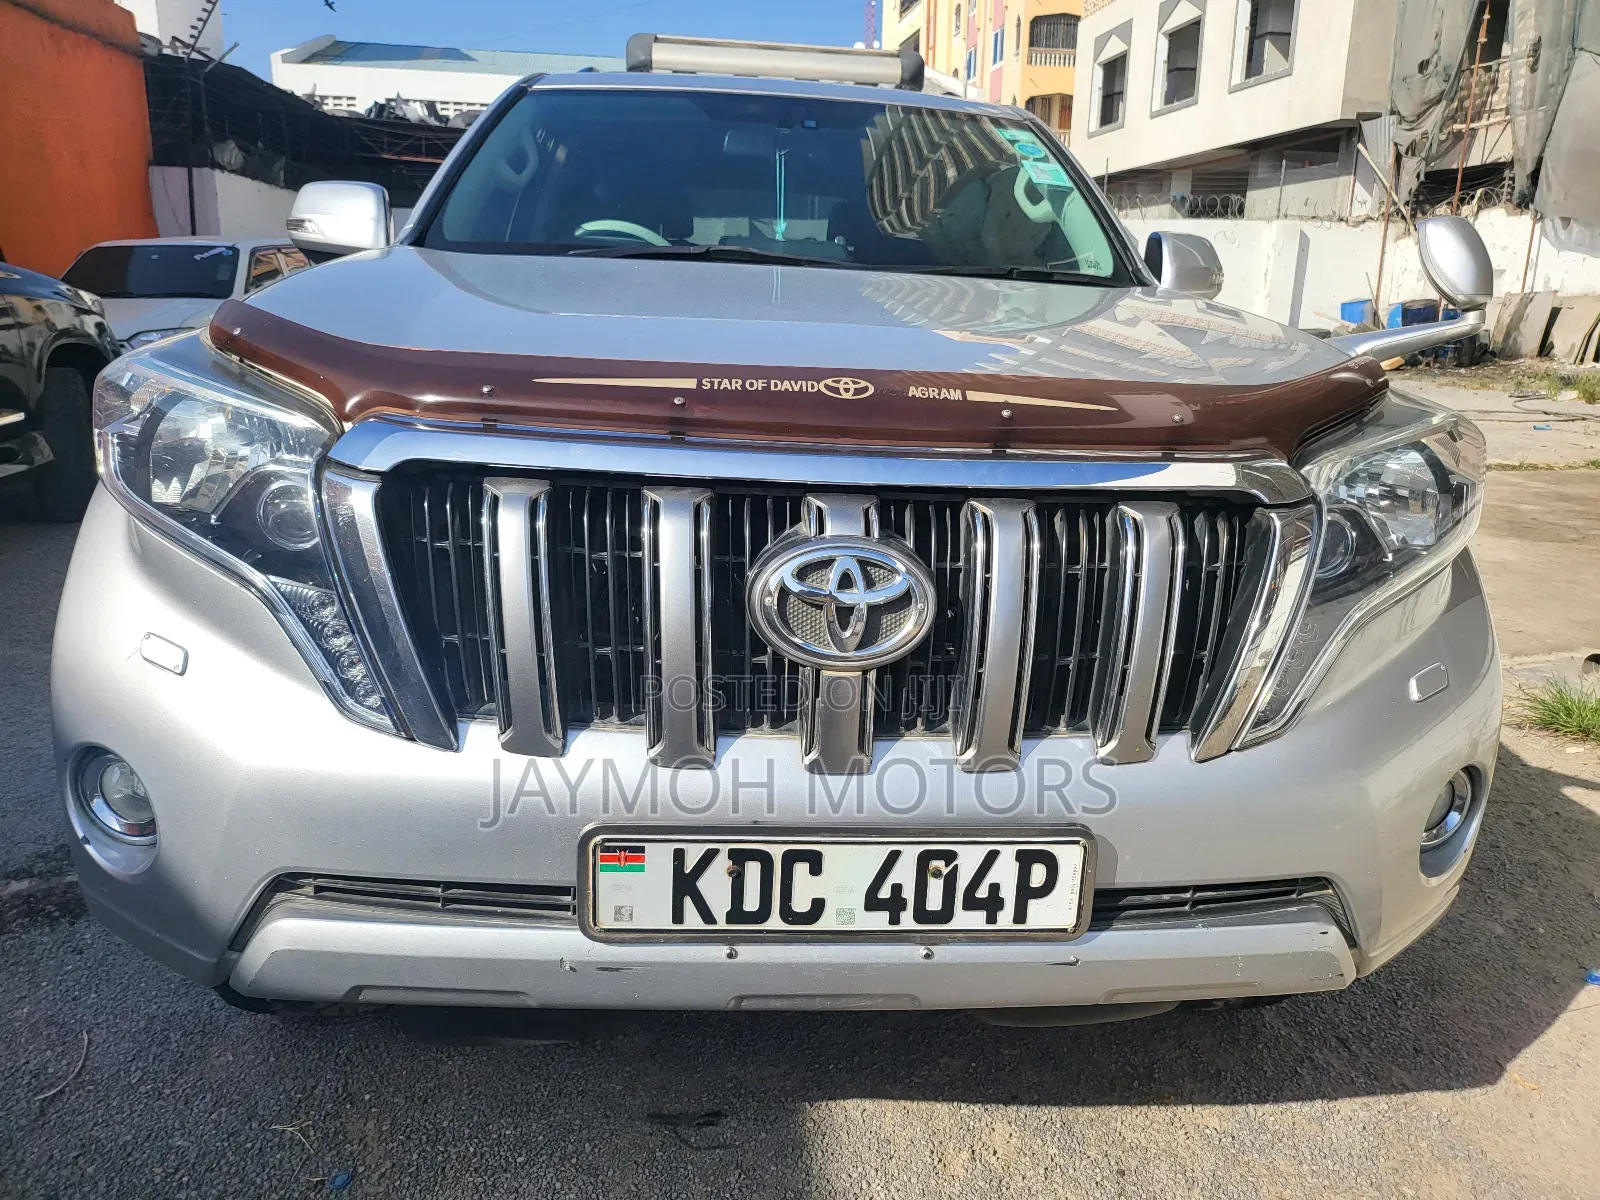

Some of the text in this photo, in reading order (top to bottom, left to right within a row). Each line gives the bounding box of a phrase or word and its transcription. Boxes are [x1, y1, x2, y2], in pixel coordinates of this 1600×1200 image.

[701, 377, 963, 401] STAR OF DAVID AGRAM
[671, 847, 825, 926] KDC
[863, 848, 1059, 926] 404P
